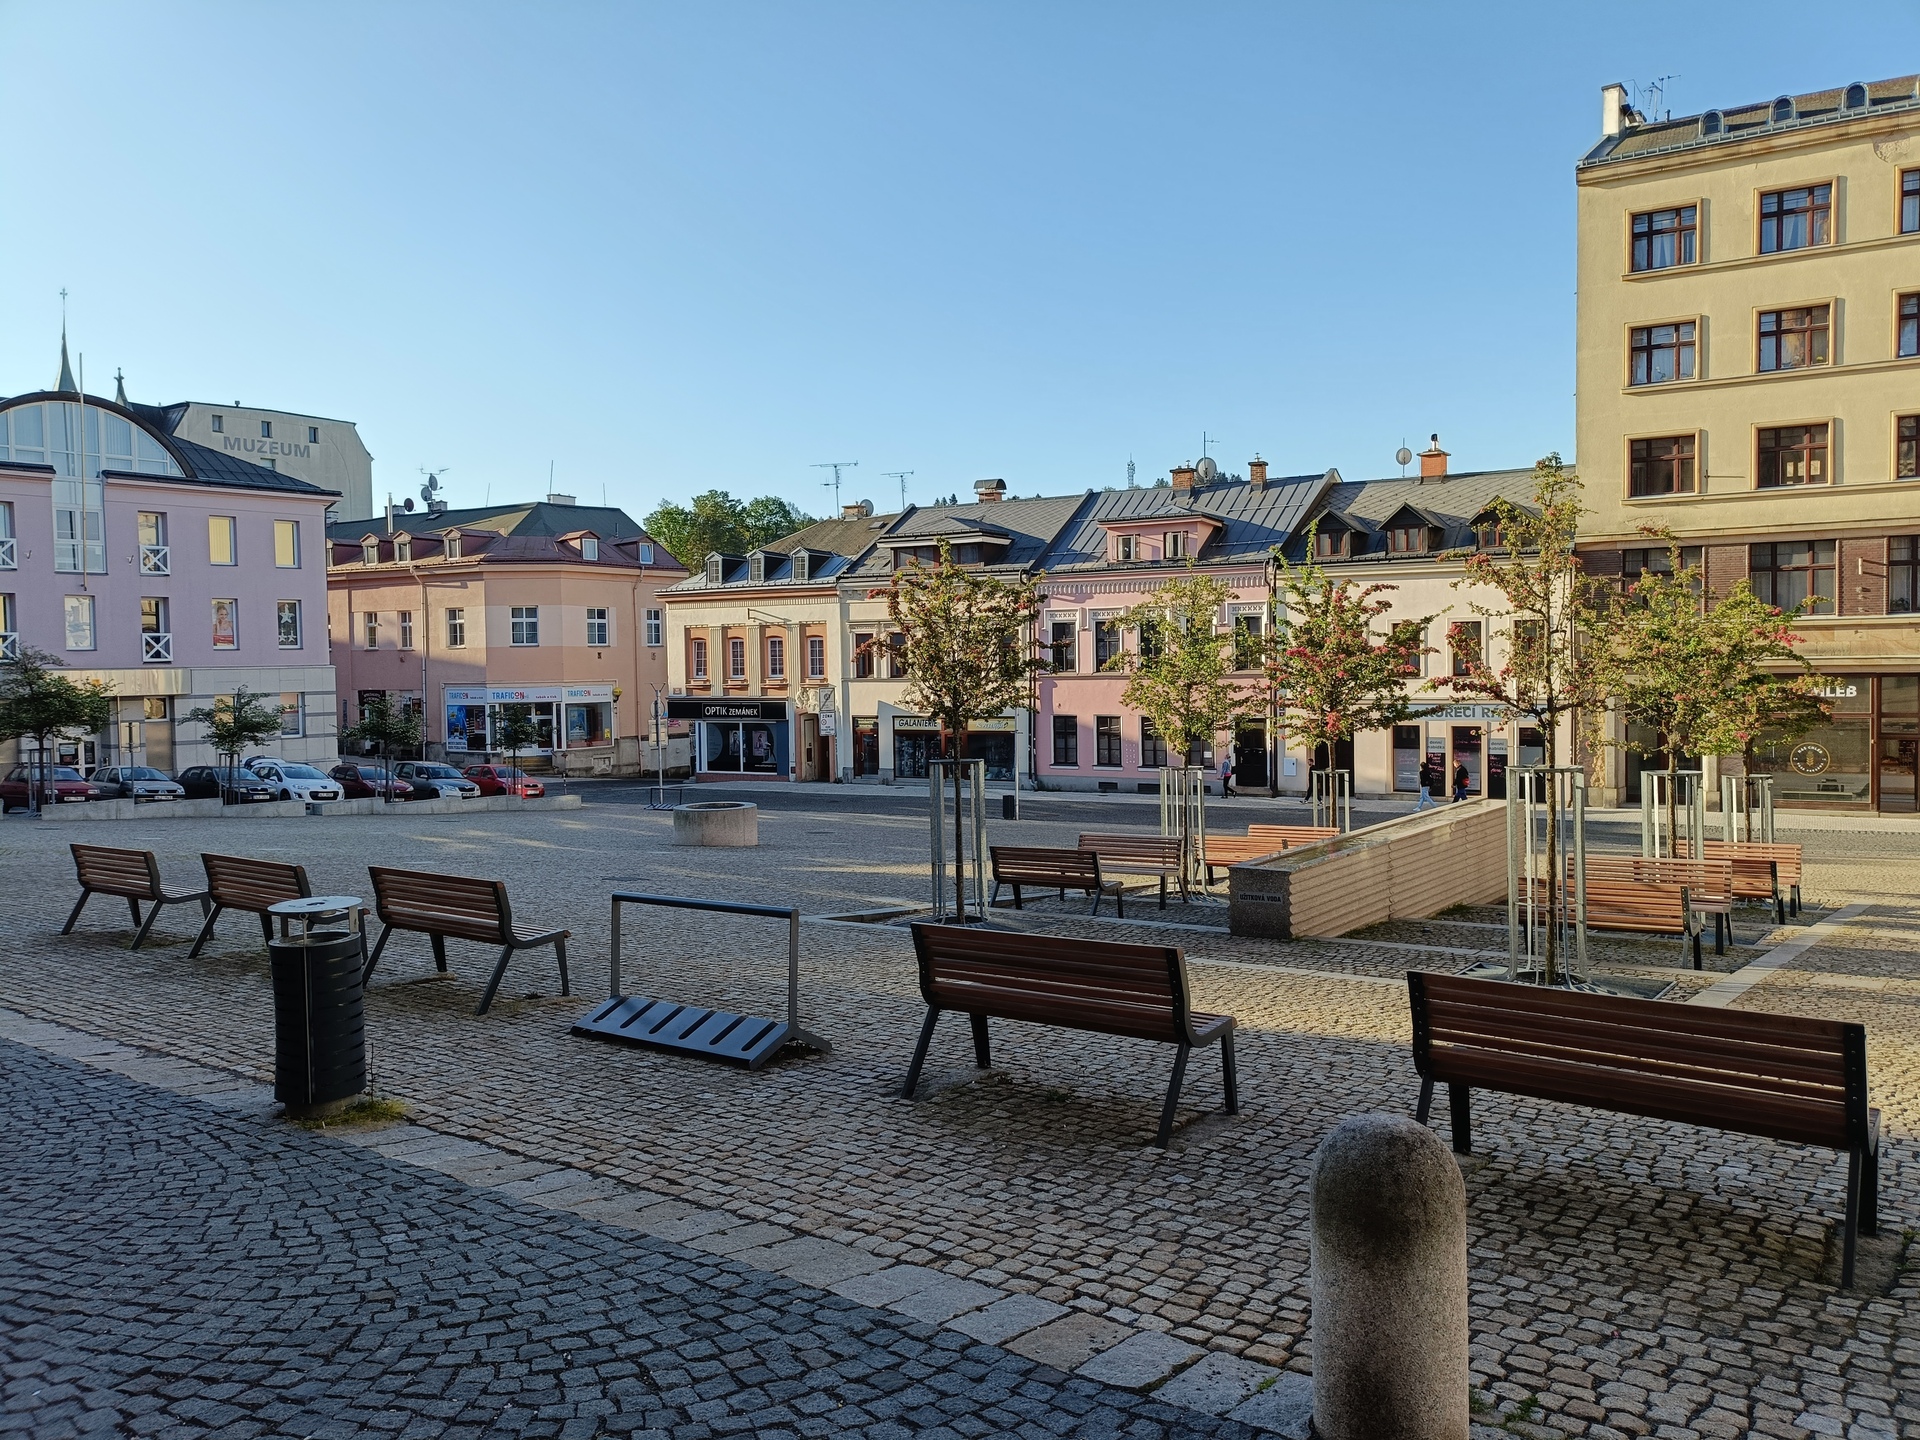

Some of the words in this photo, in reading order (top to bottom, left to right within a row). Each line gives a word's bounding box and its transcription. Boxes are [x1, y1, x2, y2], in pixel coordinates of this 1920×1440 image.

[223, 436, 311, 459] MUZEUM
[492, 691, 525, 700] TRAFICON
[704, 706, 728, 716] OPTIK
[728, 706, 758, 716] ZEMÁNEK
[898, 718, 938, 728] GALANTERIE
